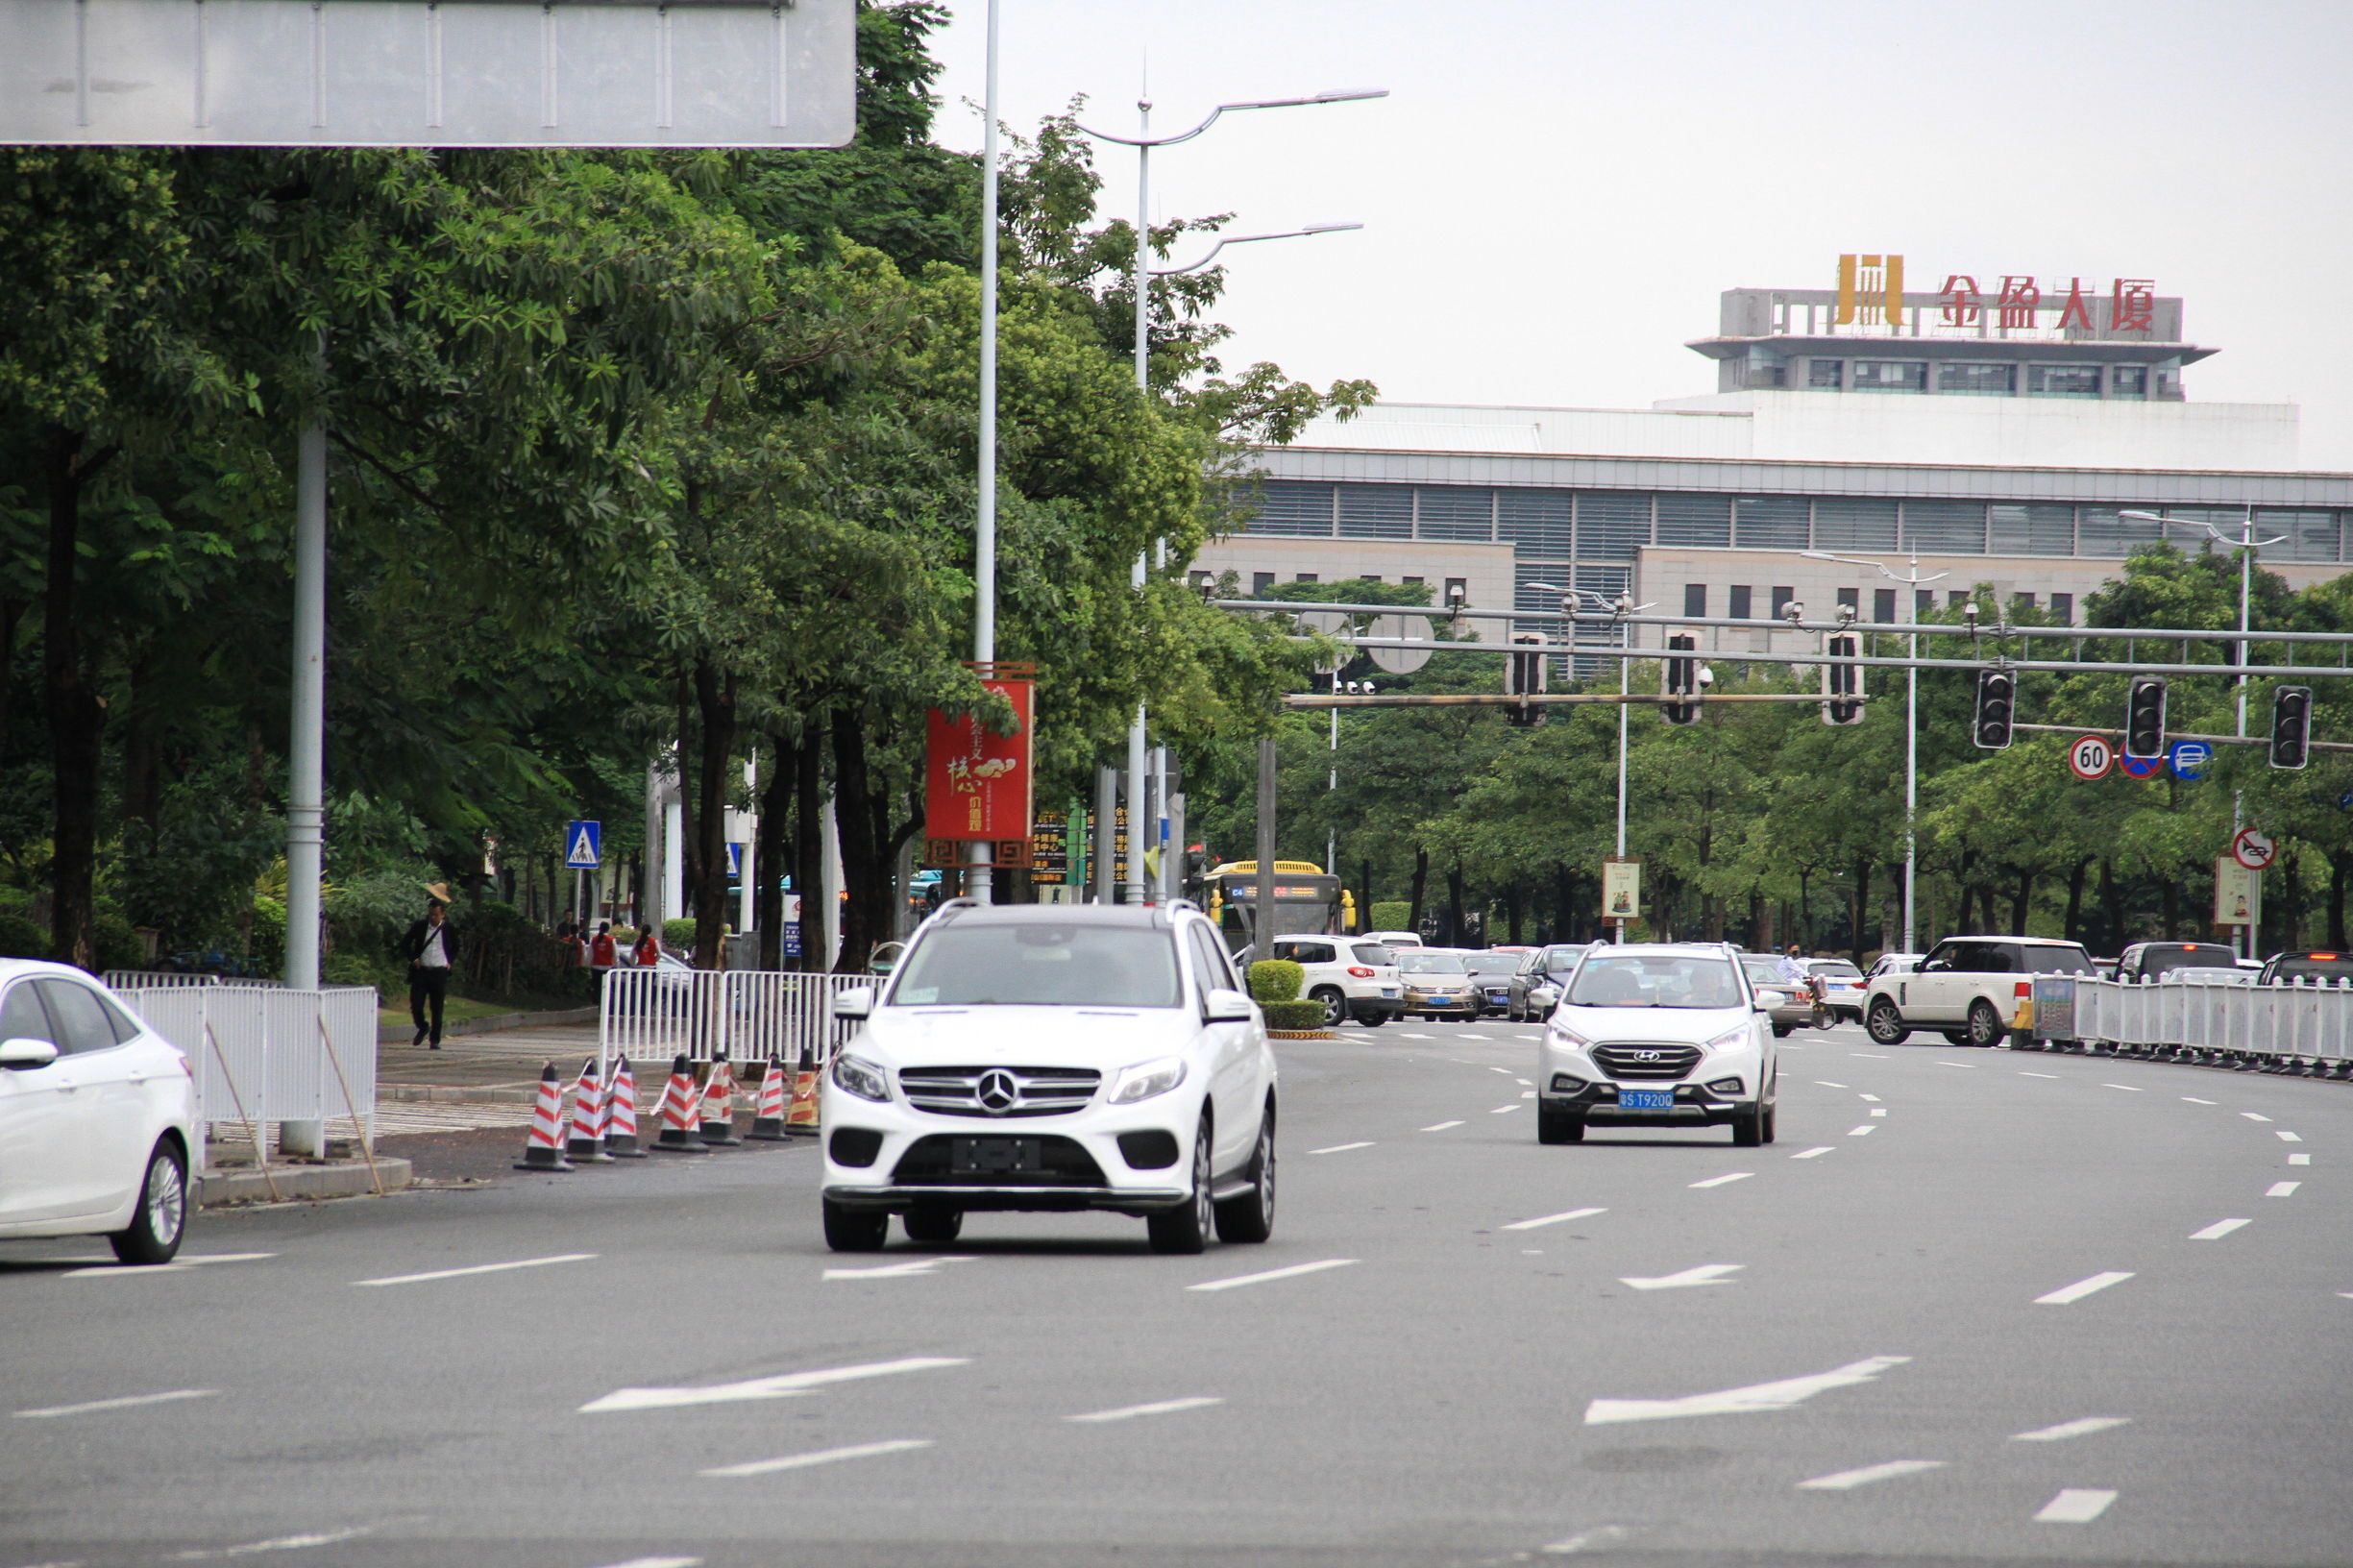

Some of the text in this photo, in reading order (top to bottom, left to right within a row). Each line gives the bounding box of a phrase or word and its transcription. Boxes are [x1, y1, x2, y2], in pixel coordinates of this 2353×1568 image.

[1936, 275, 2155, 331] 金盈大厦
[2080, 746, 2103, 768] 60
[1232, 888, 1243, 897] C4
